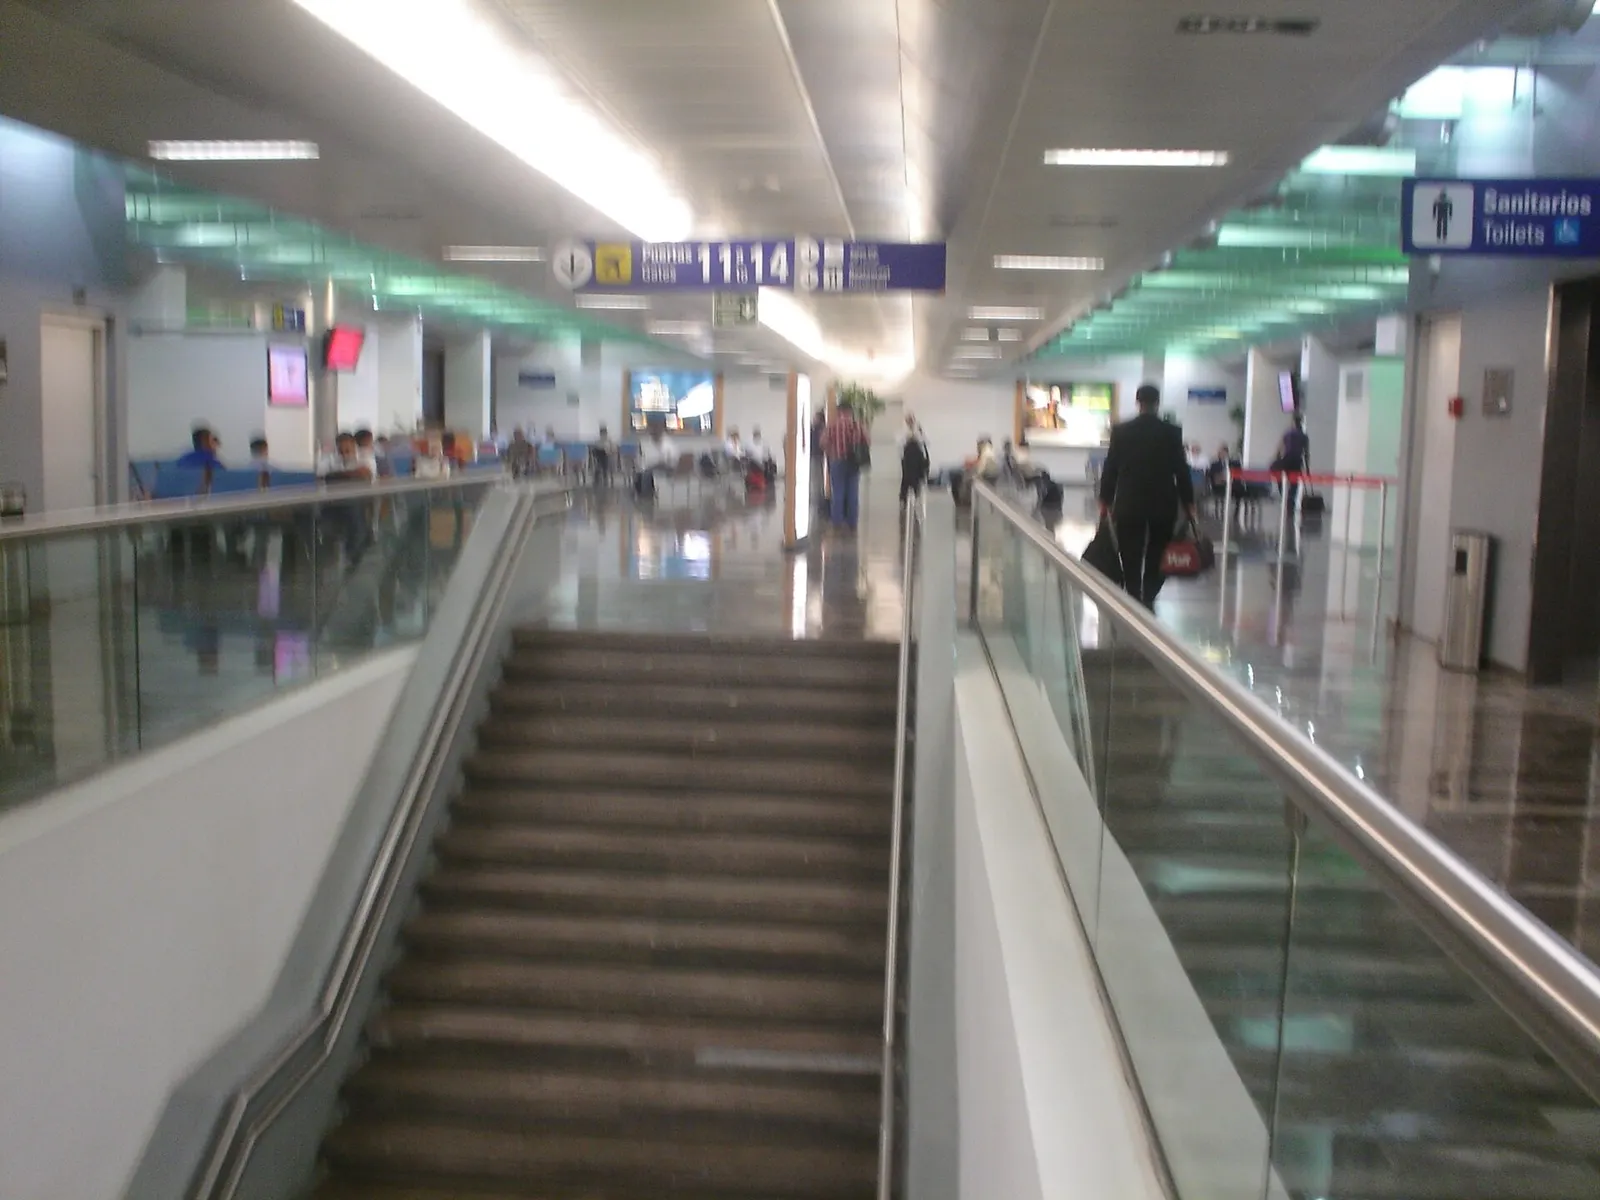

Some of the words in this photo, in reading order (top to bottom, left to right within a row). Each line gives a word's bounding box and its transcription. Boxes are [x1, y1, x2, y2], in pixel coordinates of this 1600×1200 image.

[1483, 188, 1592, 216] Sanitarios
[1484, 219, 1545, 246] Toilets
[697, 242, 731, 284] 11
[750, 242, 789, 284] 14
